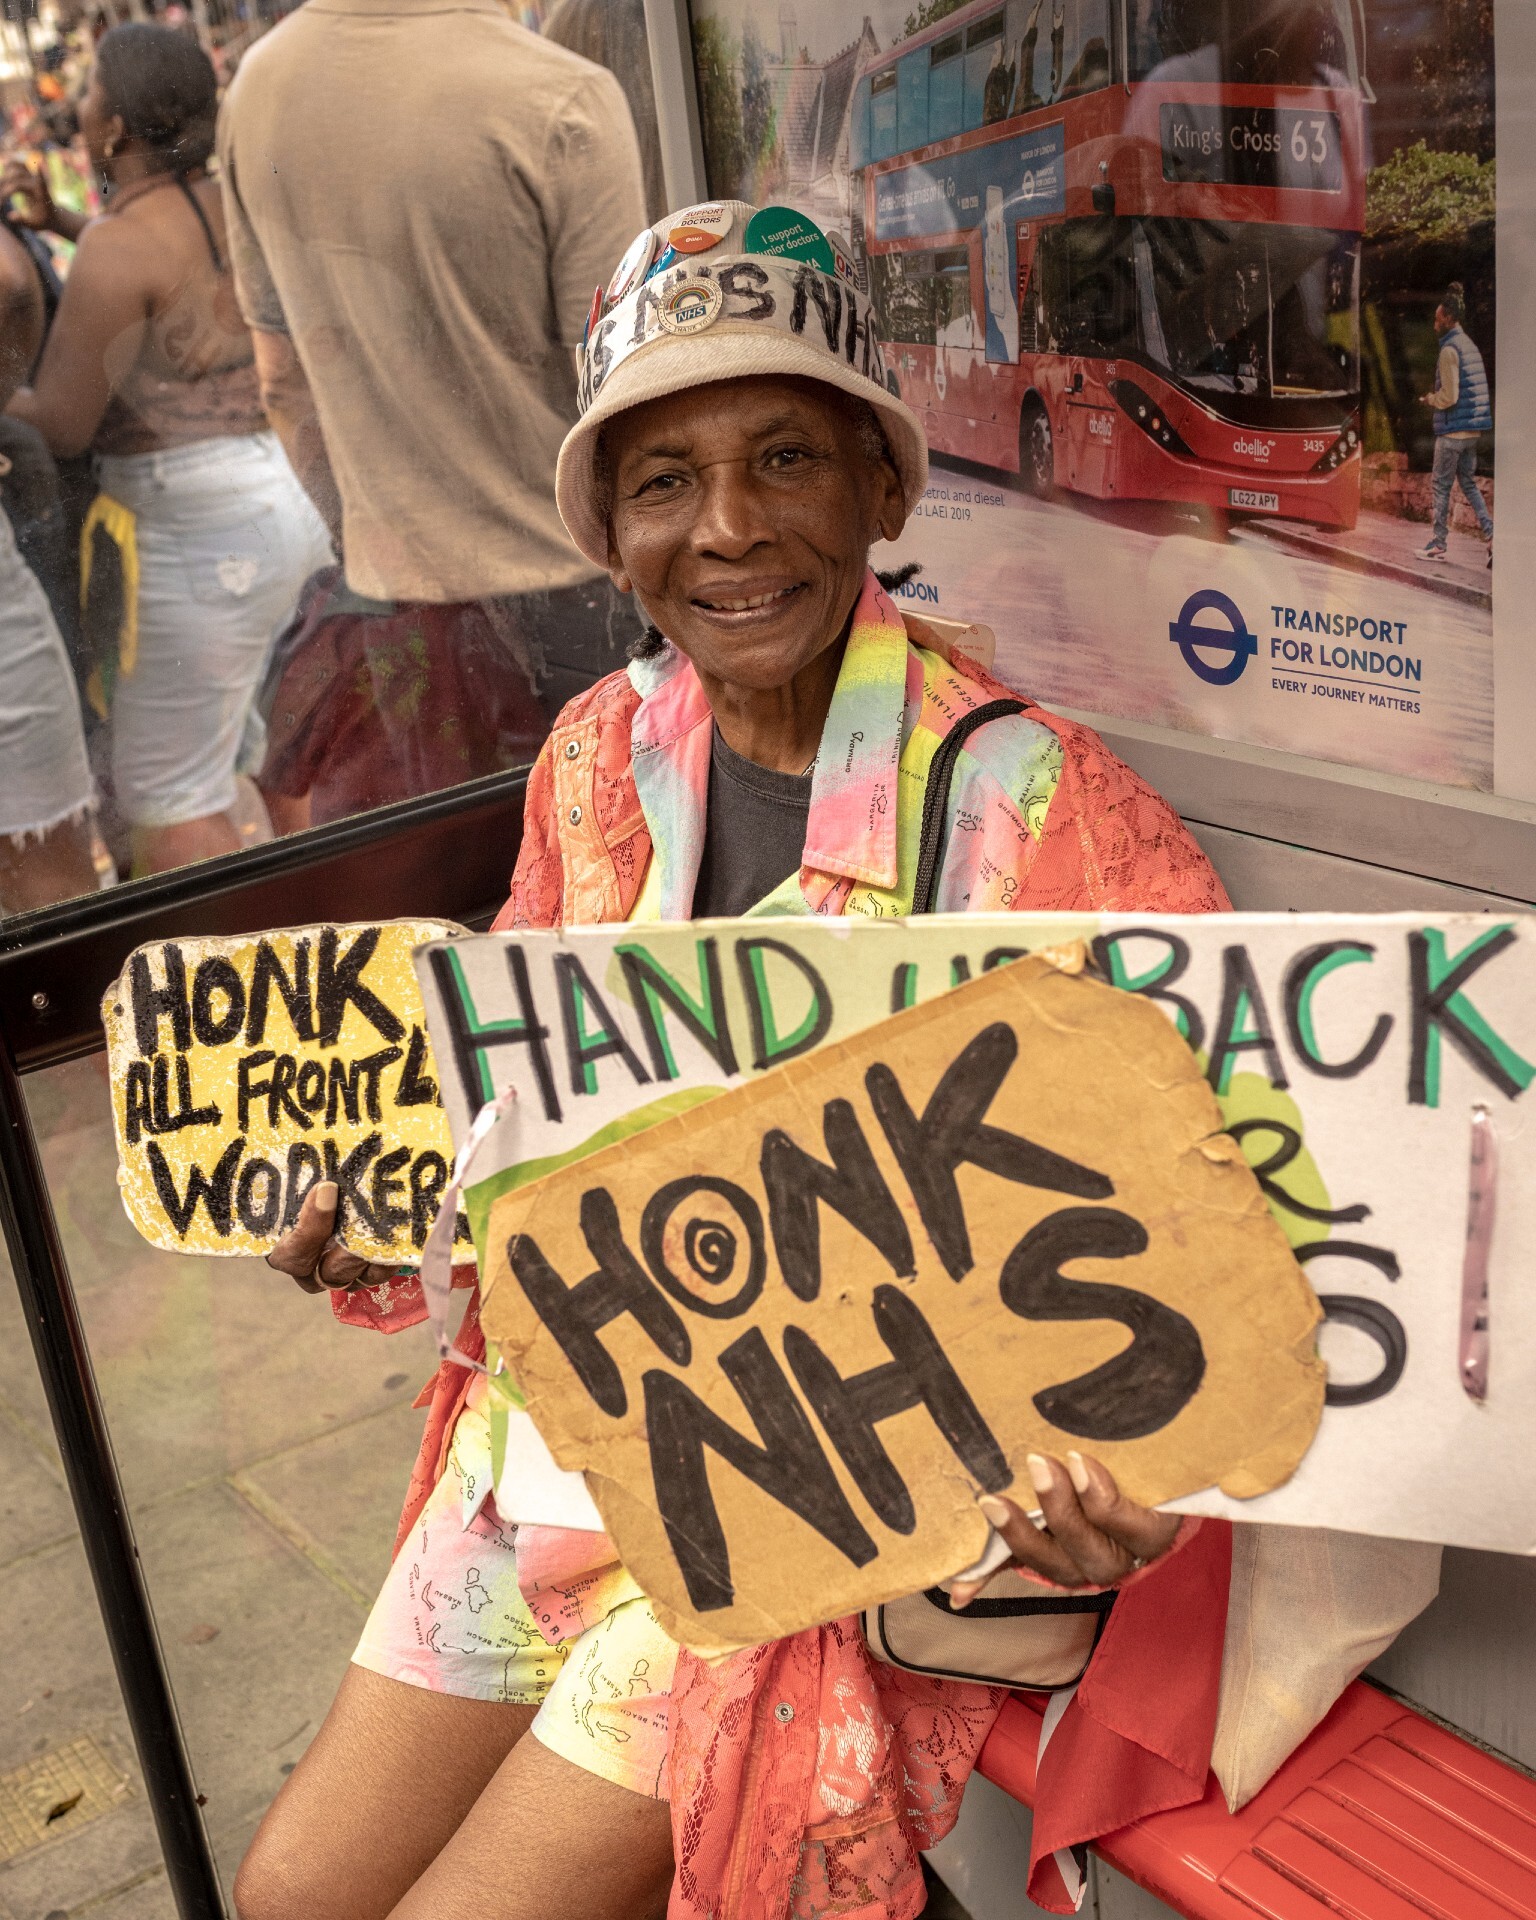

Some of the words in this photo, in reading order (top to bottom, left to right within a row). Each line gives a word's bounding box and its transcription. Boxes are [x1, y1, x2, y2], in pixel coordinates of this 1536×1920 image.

[1174, 124, 1223, 155] King's
[1230, 126, 1281, 152] Cross
[1291, 120, 1328, 163] 63
[681, 216, 722, 227] DOCTORS
[685, 208, 725, 218] SUPPORT
[761, 235, 768, 244] I
[767, 224, 804, 243] support
[786, 233, 820, 250] doctors
[833, 250, 861, 291] OPE
[677, 306, 704, 322] NHS
[1233, 436, 1270, 457] abellio
[1303, 439, 1325, 453] 3435
[925, 505, 948, 519] LAEI
[951, 506, 973, 522] 2019.
[953, 490, 972, 503] and
[974, 491, 1006, 507] diesel
[1233, 490, 1257, 506] LG22
[1258, 493, 1277, 508] APY
[889, 582, 939, 604] NDON
[1271, 605, 1408, 645] TRANSPORT
[1270, 637, 1314, 664] FOR
[1319, 645, 1422, 682] LONDON
[946, 678, 977, 708] OCEAN
[1272, 678, 1307, 694] EVERY
[1311, 684, 1366, 704] JOURNEY
[1368, 694, 1421, 714] MATTERS
[844, 738, 856, 773] GRENADA
[130, 926, 407, 1057] HONK
[431, 936, 834, 1123] HAND
[1092, 924, 1536, 1108] BACK
[125, 1053, 222, 1147] ALL
[146, 1130, 476, 1250] WORKER
[506, 1021, 1114, 1420] HONK
[641, 1207, 1208, 1612] NHS
[467, 1631, 493, 1646] BEACH
